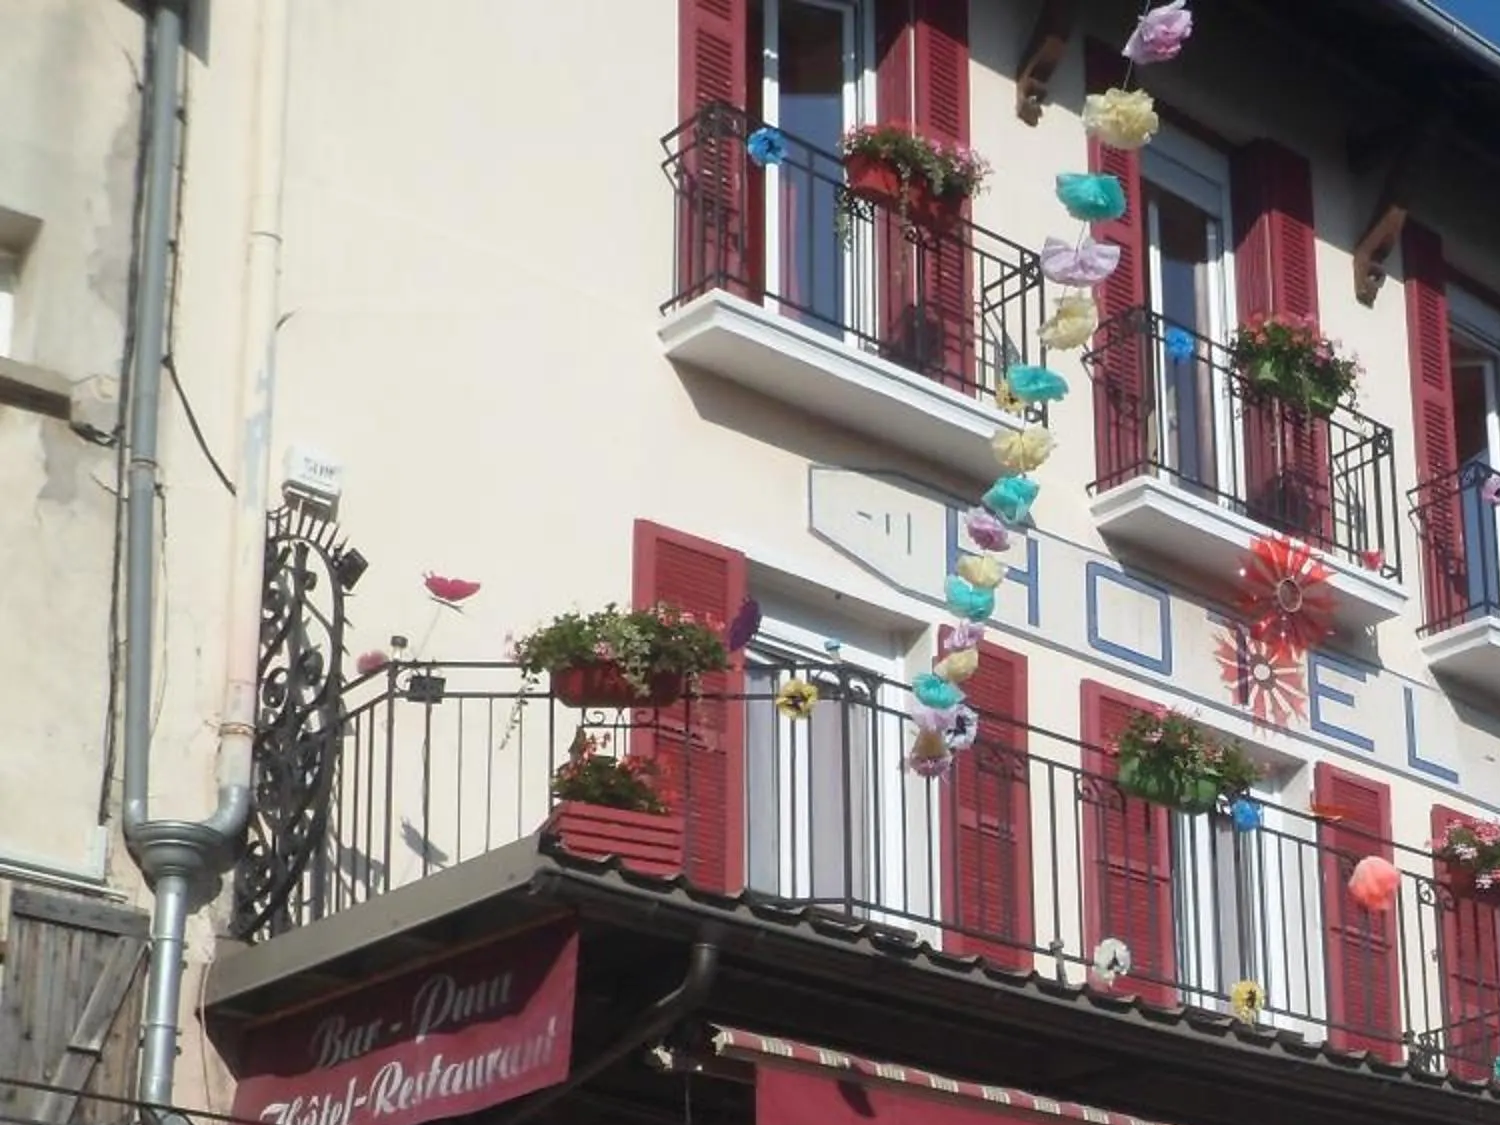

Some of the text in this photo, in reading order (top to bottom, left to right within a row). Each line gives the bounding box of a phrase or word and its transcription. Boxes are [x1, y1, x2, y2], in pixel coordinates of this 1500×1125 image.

[945, 504, 1460, 785] HOTEL
[311, 1014, 383, 1068] Bar
[411, 973, 513, 1044] Pmu
